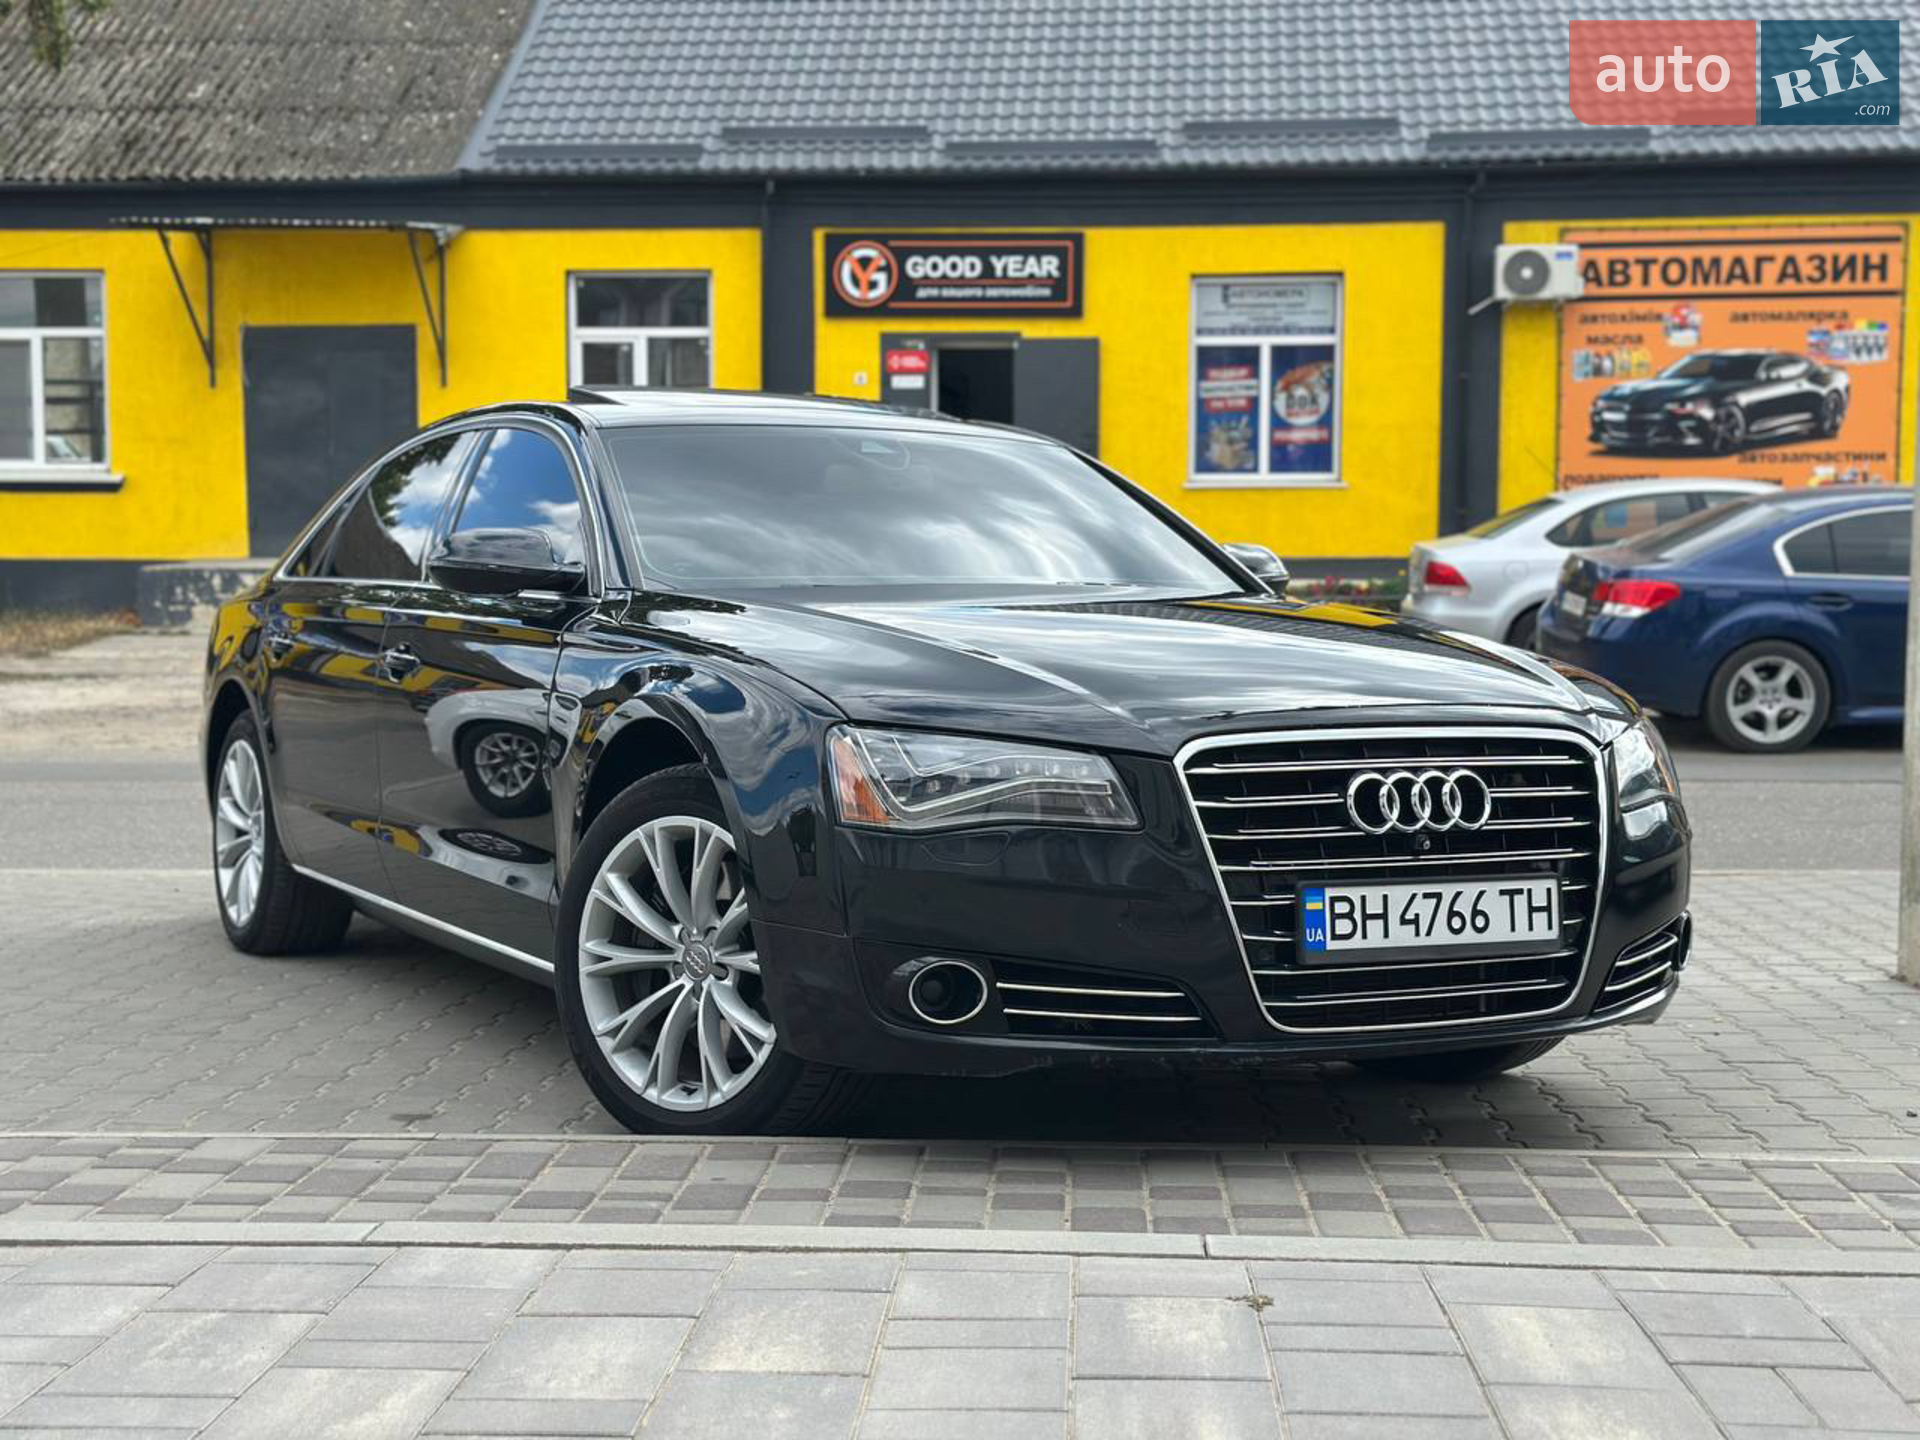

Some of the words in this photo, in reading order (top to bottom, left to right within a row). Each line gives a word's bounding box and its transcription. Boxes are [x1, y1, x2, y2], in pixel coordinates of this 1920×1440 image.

[905, 255, 982, 279] GOOD
[989, 255, 1060, 279] YEAR
[1580, 253, 1889, 289] АВТОМАГАЗИН
[1586, 334, 1644, 346] масла
[1329, 892, 1391, 942] BH
[1398, 889, 1491, 939] 4766
[1499, 886, 1554, 934] TH
[1306, 928, 1325, 943] UA
